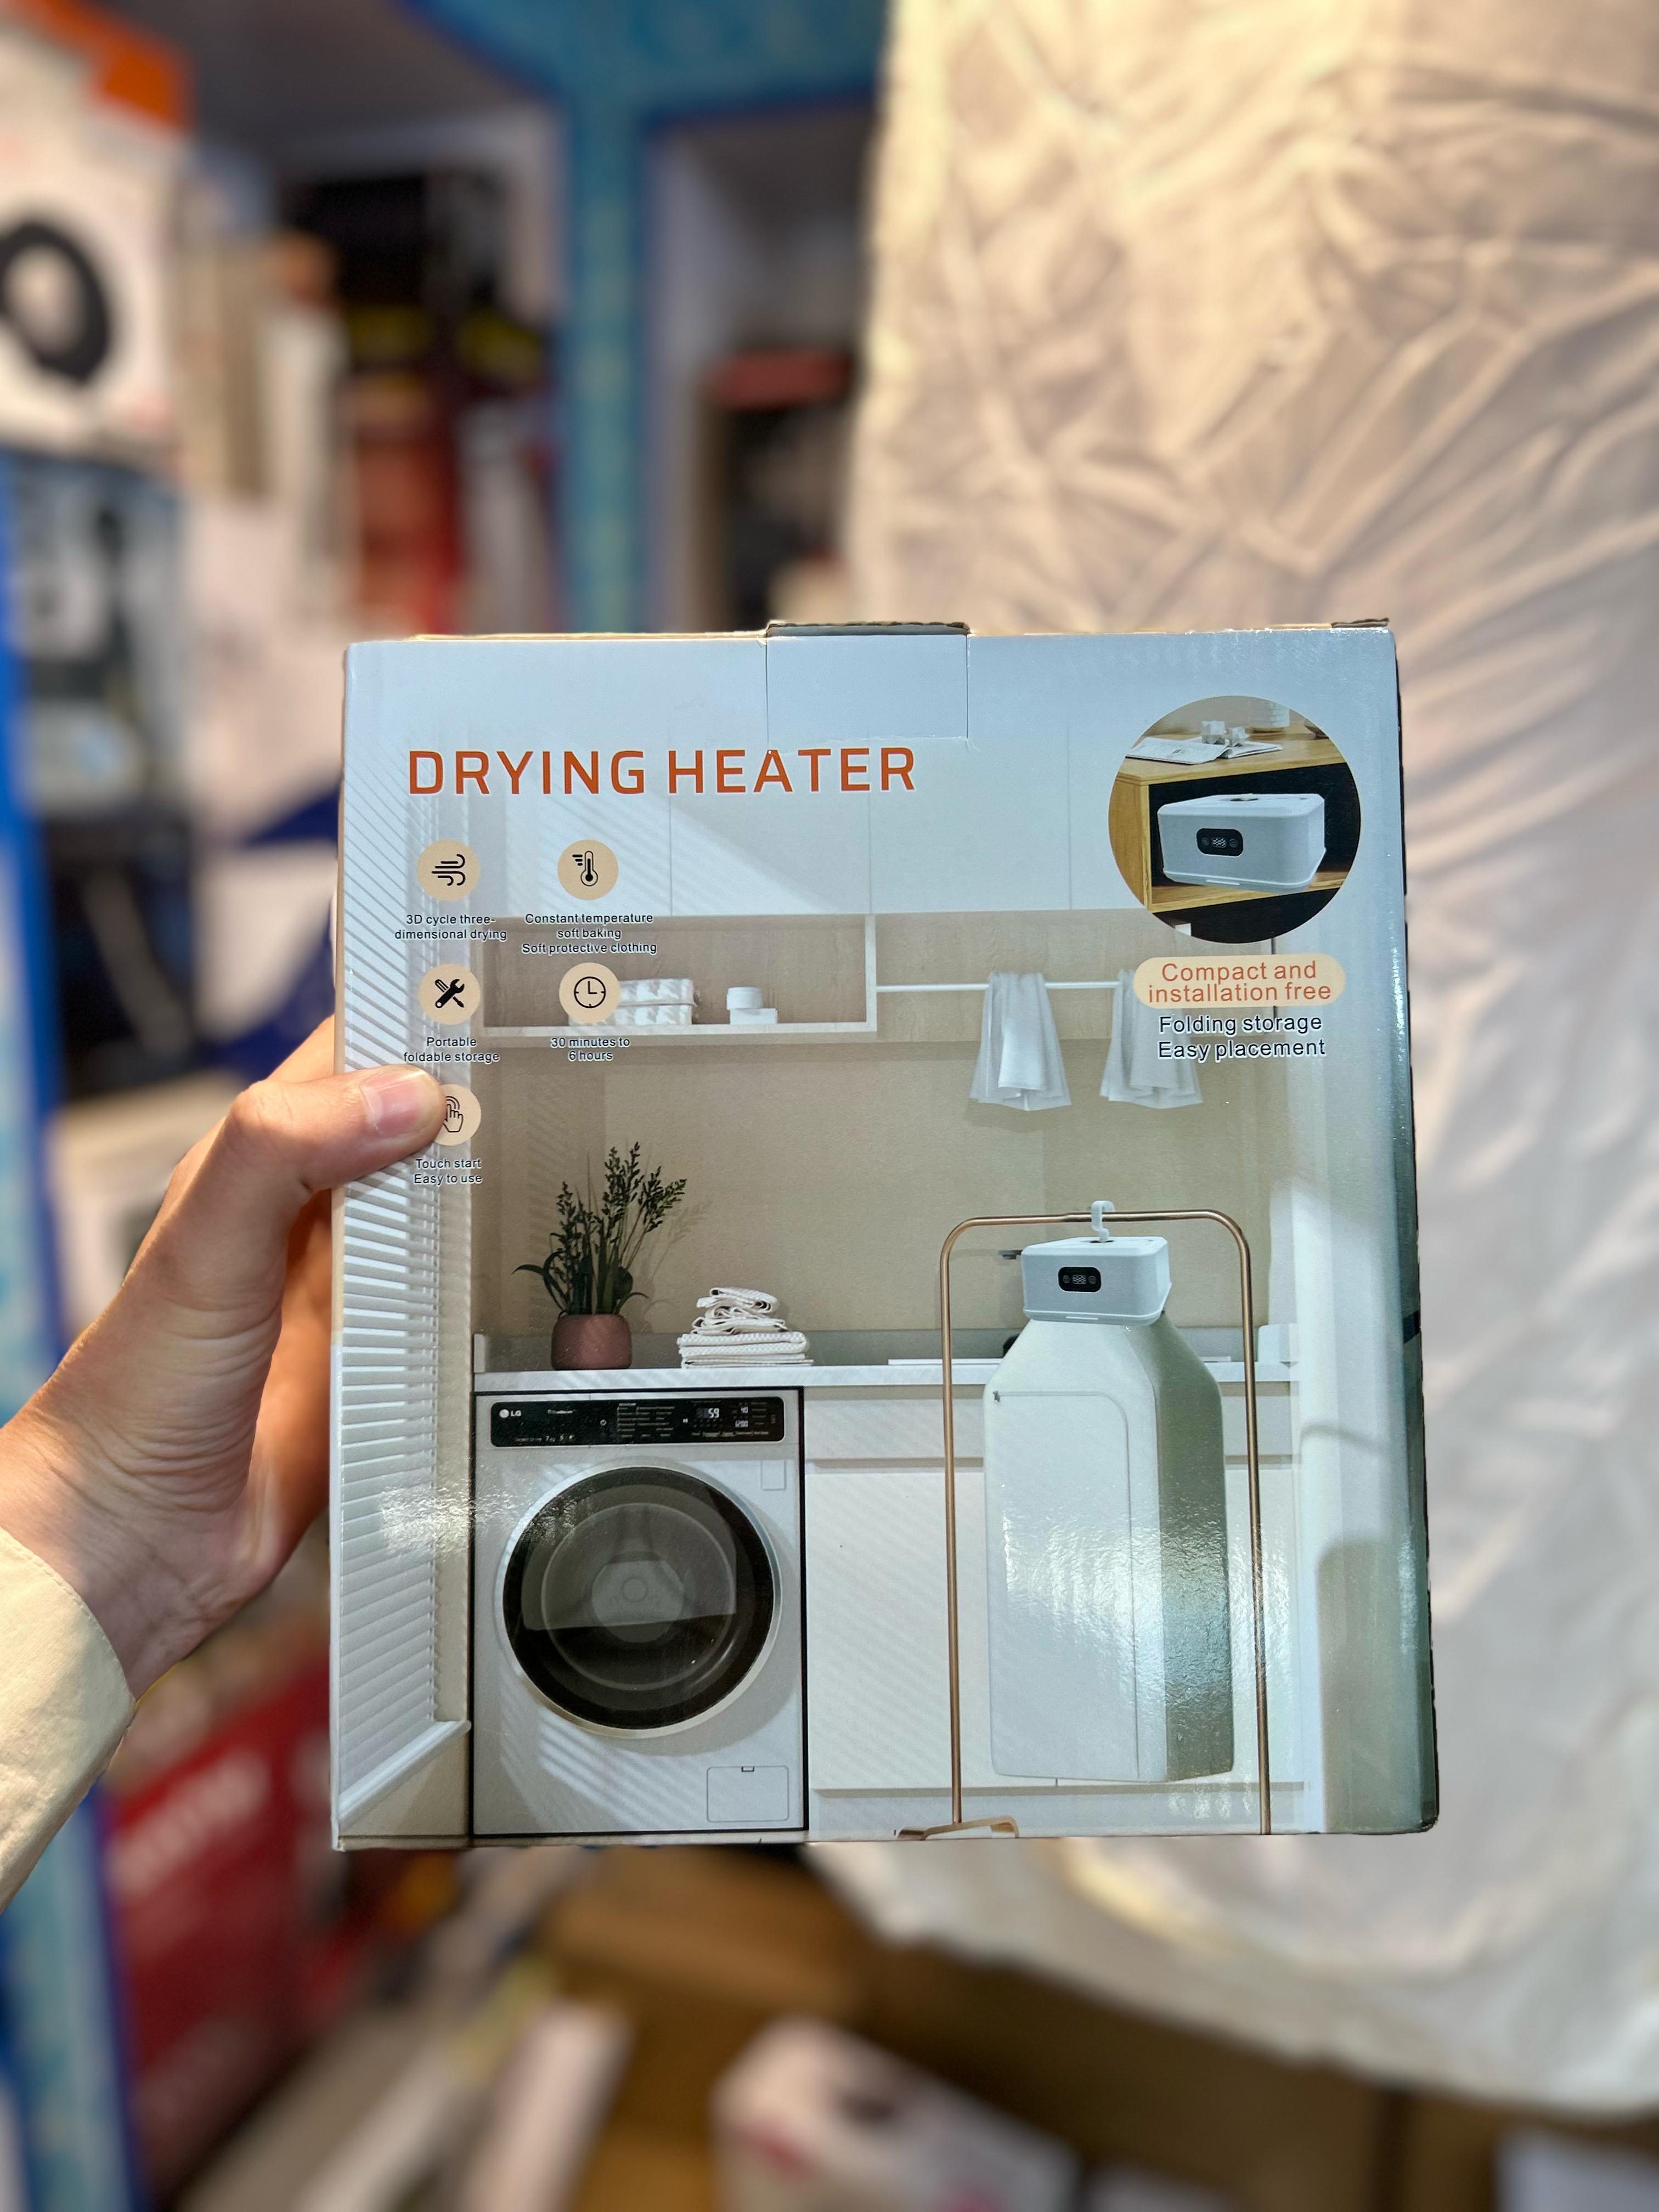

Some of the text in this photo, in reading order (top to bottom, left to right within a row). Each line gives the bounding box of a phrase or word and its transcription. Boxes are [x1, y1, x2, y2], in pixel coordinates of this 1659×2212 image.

[409, 747, 915, 794] DRYING HEATER
[407, 914, 495, 926] 3D cycle three-
[525, 913, 653, 925] Constant temperature
[394, 929, 506, 941] dimensional drying
[557, 928, 621, 940] soft baking
[522, 943, 657, 955] Soft protective clothing
[1161, 961, 1316, 985] Compact and
[1149, 981, 1331, 1002] installation free
[1160, 1015, 1322, 1036] Folding storage
[426, 1036, 477, 1046] Portable
[551, 1037, 630, 1047] 30 minutes to
[569, 1050, 613, 1060] 6 hours
[1159, 1039, 1325, 1060] Easy placement
[403, 1052, 499, 1064] foldable storage
[415, 1159, 481, 1169] Touch start
[414, 1173, 482, 1185] Easy to use
